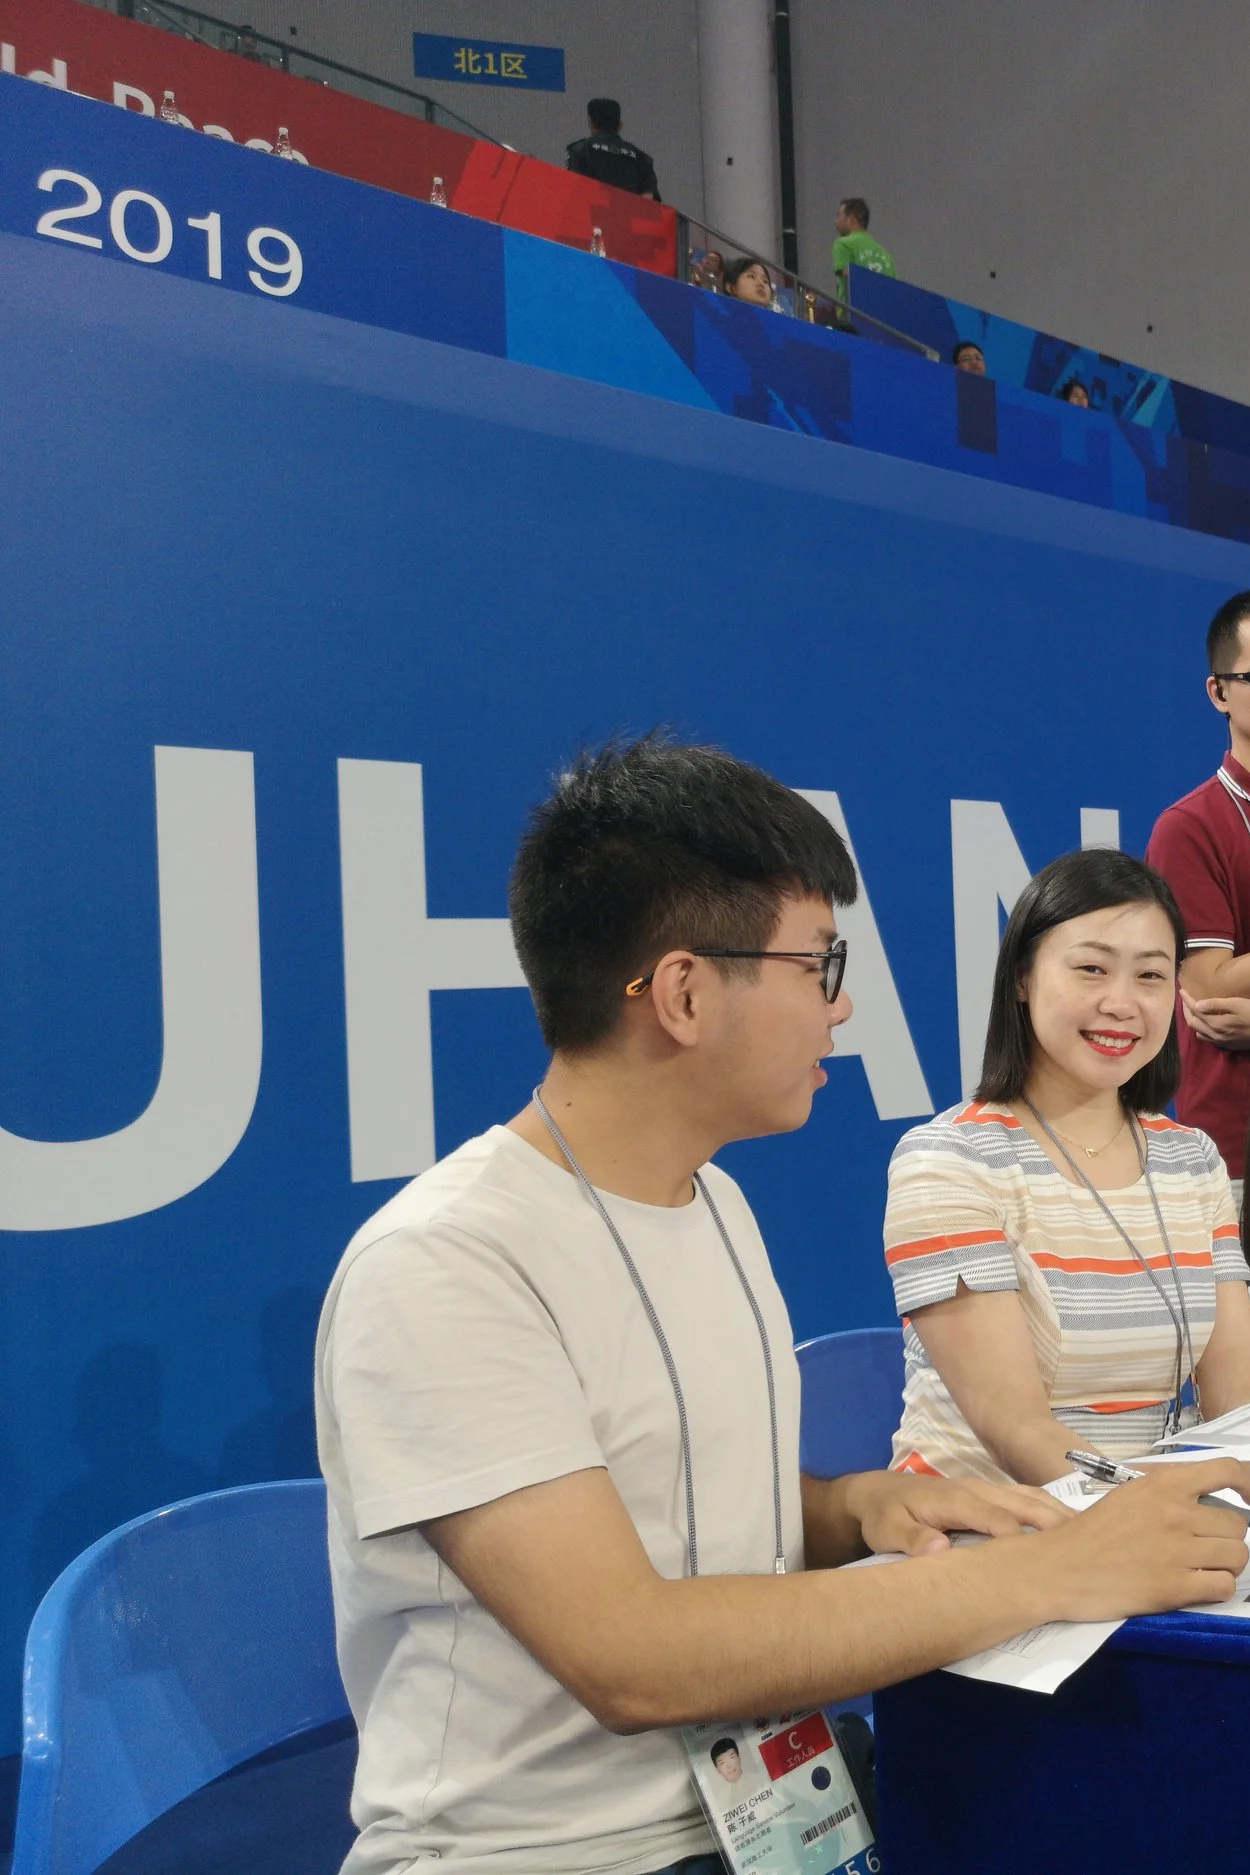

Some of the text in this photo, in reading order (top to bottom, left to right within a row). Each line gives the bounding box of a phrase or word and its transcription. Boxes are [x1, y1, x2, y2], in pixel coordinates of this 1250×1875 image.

[454, 48, 528, 80] 北1区
[36, 168, 303, 297] 2019
[786, 1745, 816, 1768] 工作人员
[788, 1731, 802, 1750] C
[722, 1787, 774, 1823] ZIWEI CHEN
